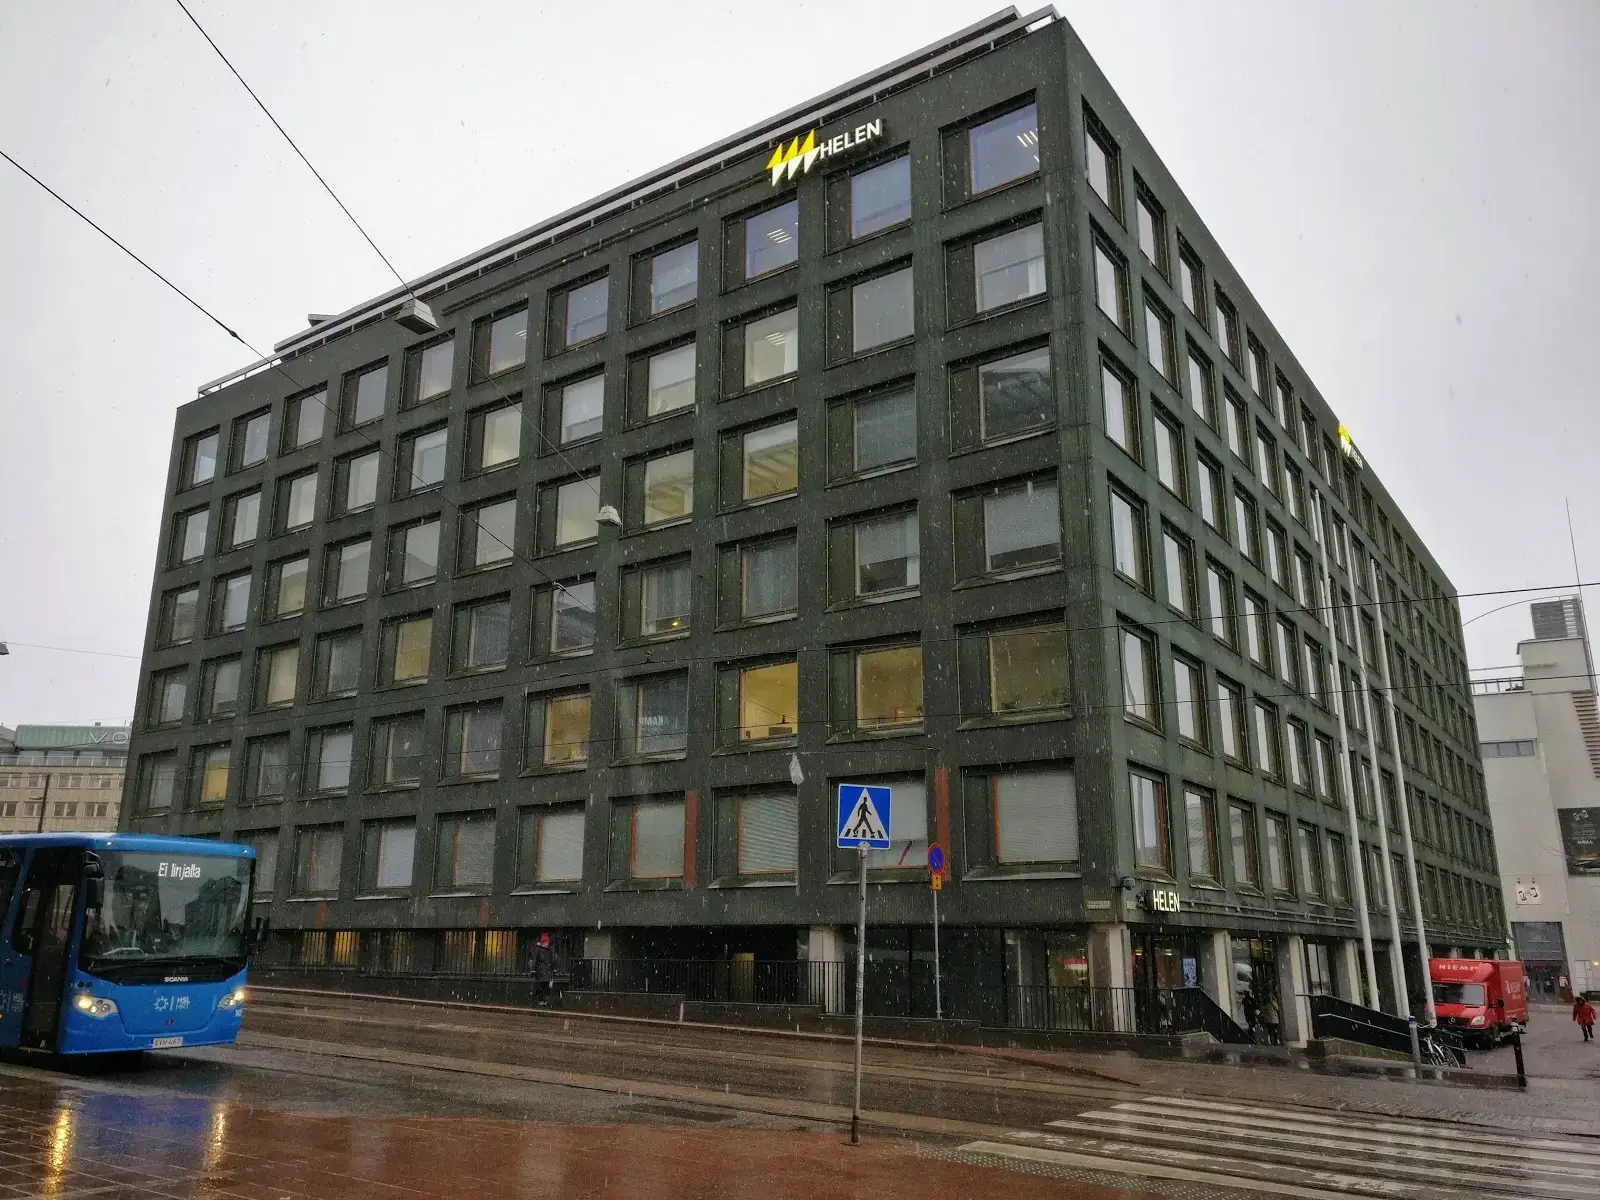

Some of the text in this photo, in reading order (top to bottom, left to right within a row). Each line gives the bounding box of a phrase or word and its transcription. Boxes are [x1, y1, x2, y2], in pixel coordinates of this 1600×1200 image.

[819, 119, 882, 160] HELEN
[158, 862, 201, 881] Ei linjalla
[1153, 889, 1180, 912] HELEN
[1438, 963, 1474, 972] NIEMI
